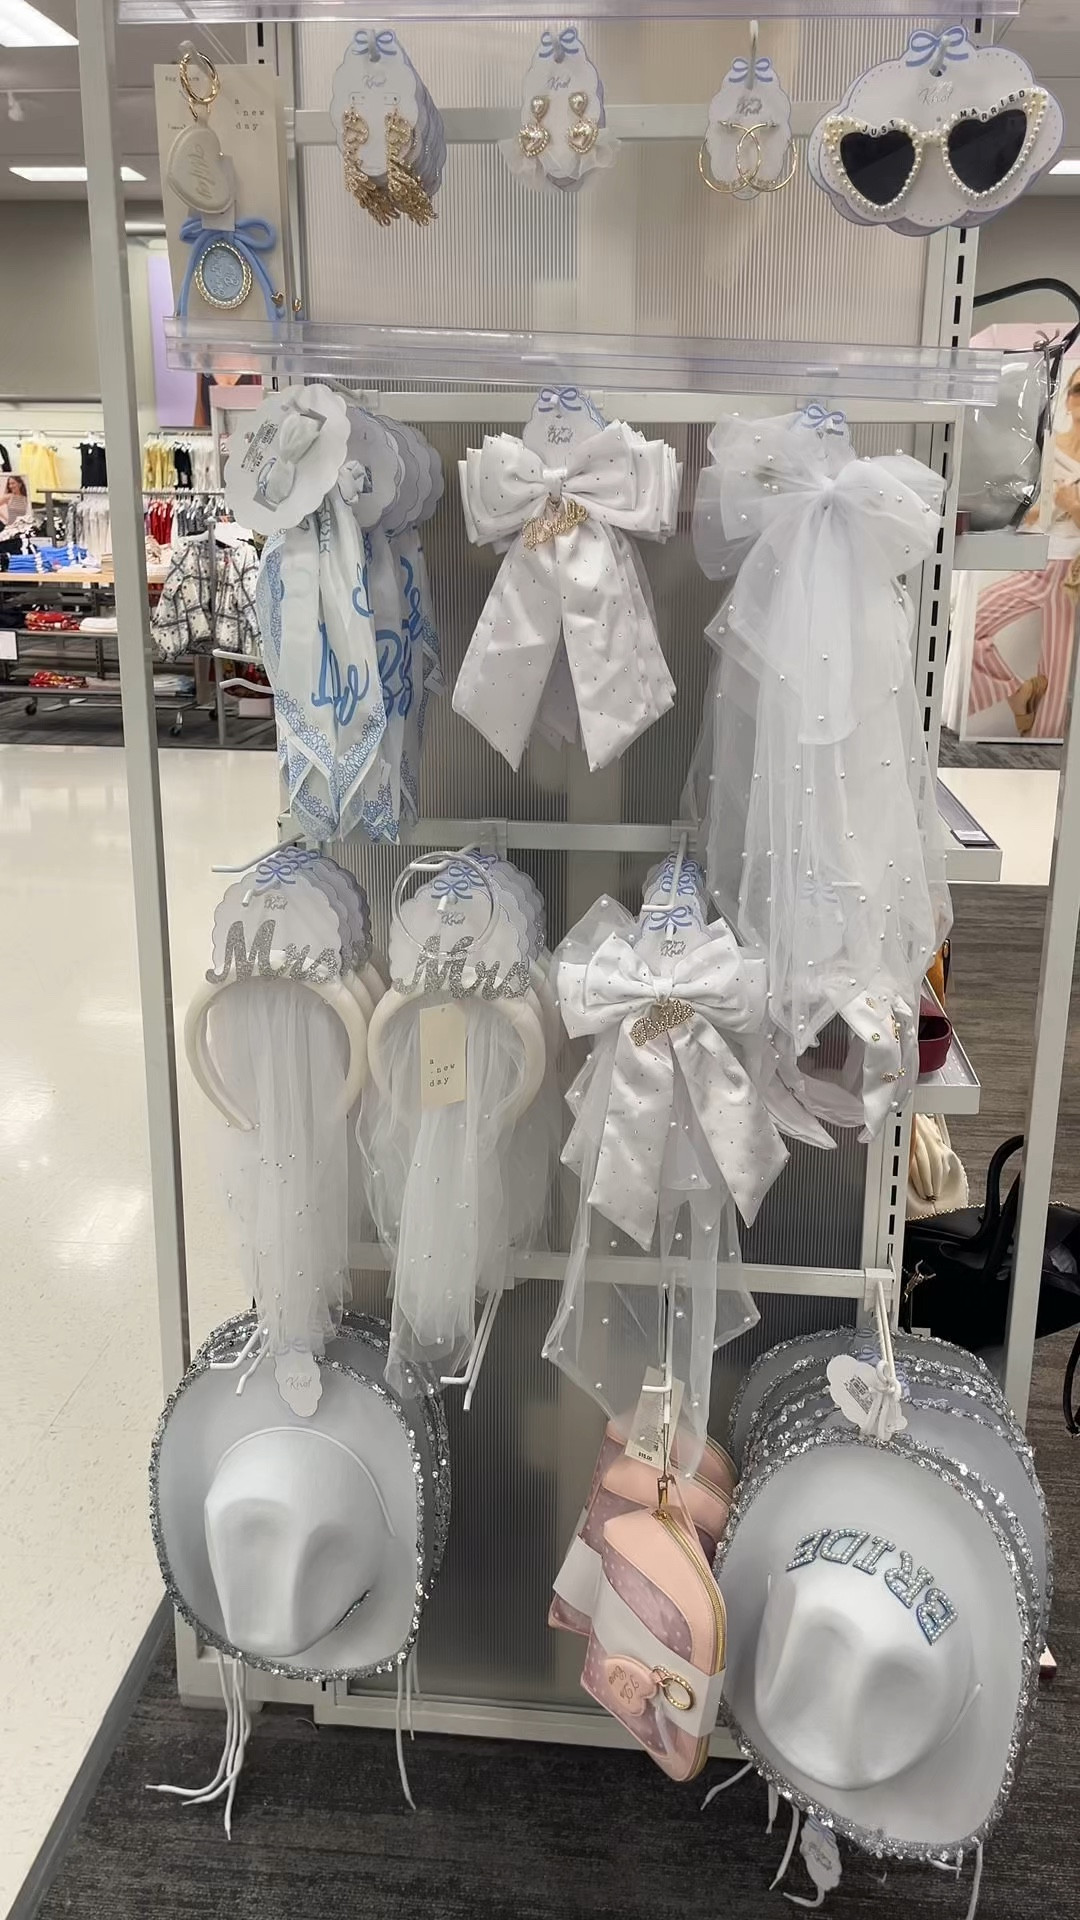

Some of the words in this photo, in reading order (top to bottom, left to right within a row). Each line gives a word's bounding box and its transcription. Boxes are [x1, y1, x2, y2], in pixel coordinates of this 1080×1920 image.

[235, 122, 259, 131] day
[861, 119, 896, 136] JUST
[959, 90, 1026, 121] MARRIED
[205, 919, 338, 984] Mrs
[393, 935, 531, 1000] Mrs
[429, 1076, 450, 1088] day
[285, 1375, 313, 1391] Knot
[785, 1527, 959, 1647] BRIDE
